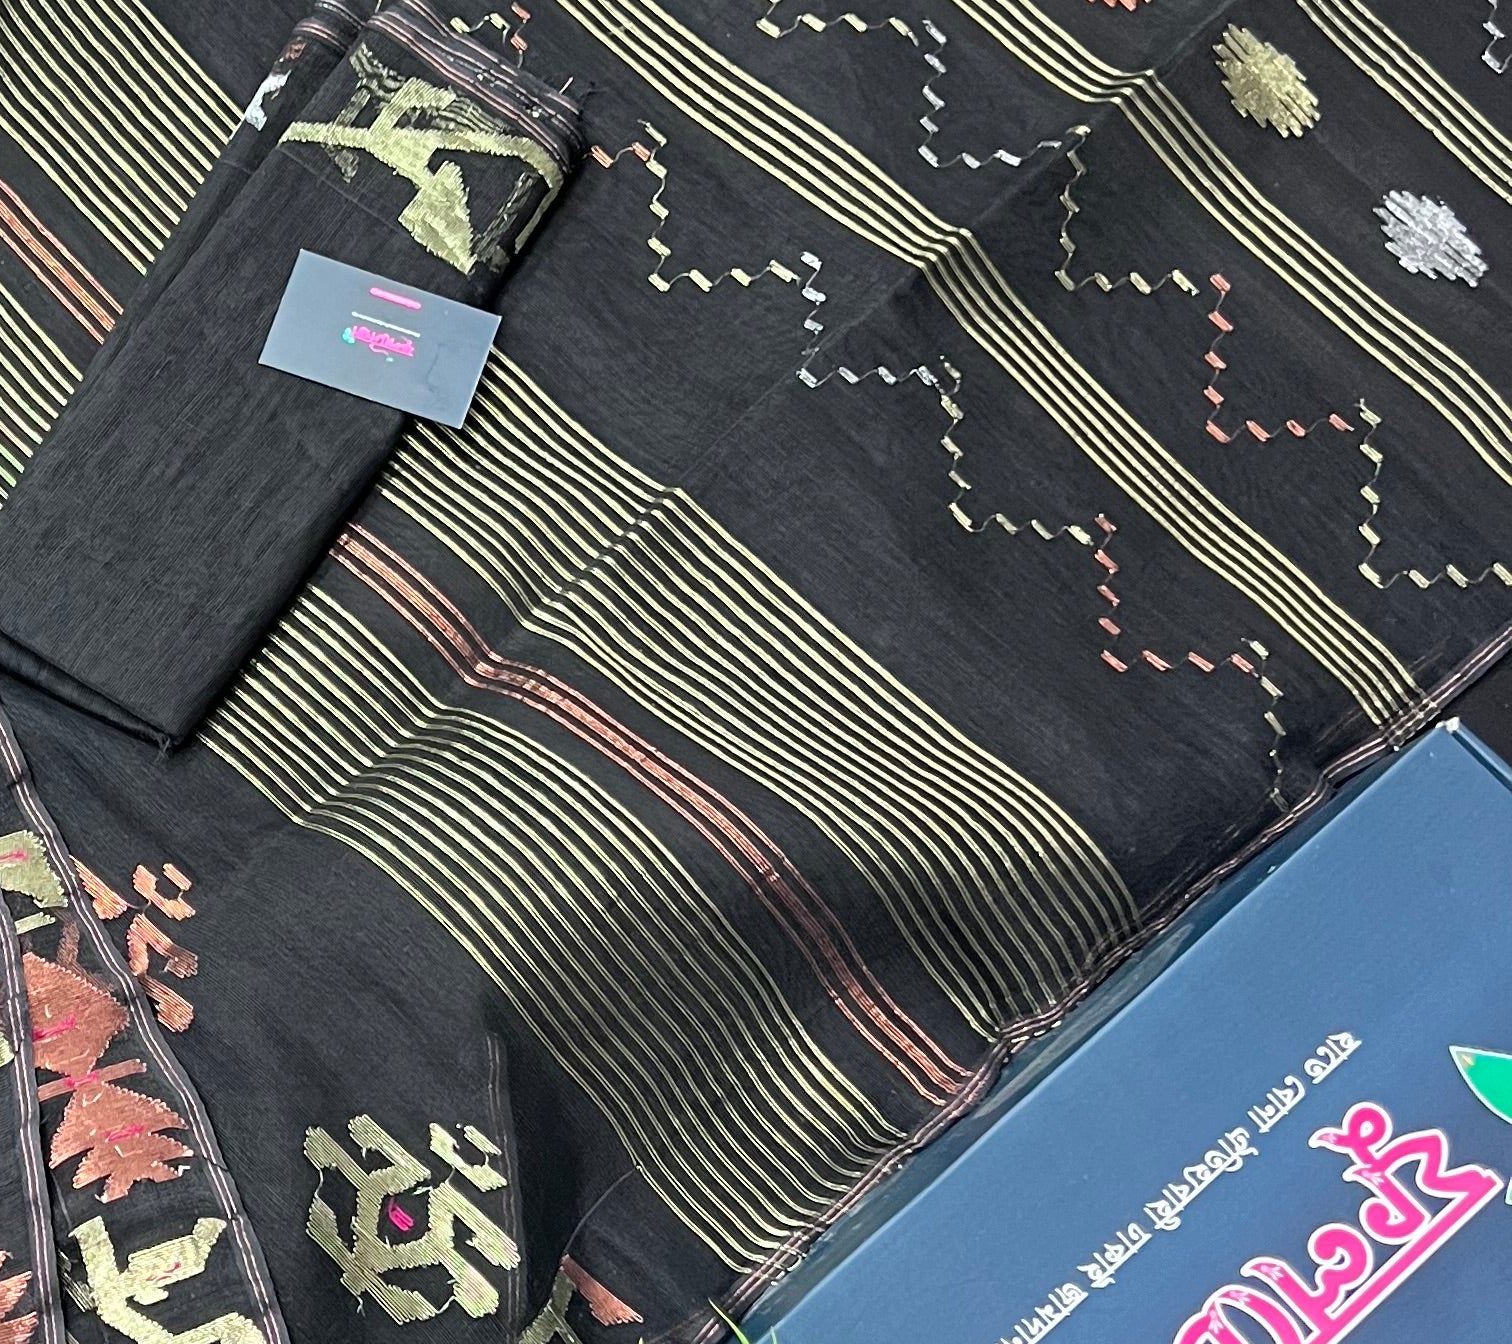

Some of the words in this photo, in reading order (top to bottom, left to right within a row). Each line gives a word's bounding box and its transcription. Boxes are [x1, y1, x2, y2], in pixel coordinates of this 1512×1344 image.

[1303, 1031, 1363, 1084] হাতে
[1247, 1075, 1306, 1134] বোনা
[1143, 1127, 1259, 1231] ঐতিহ্যবাহী
[1077, 1223, 1152, 1289] ঢাকাই
